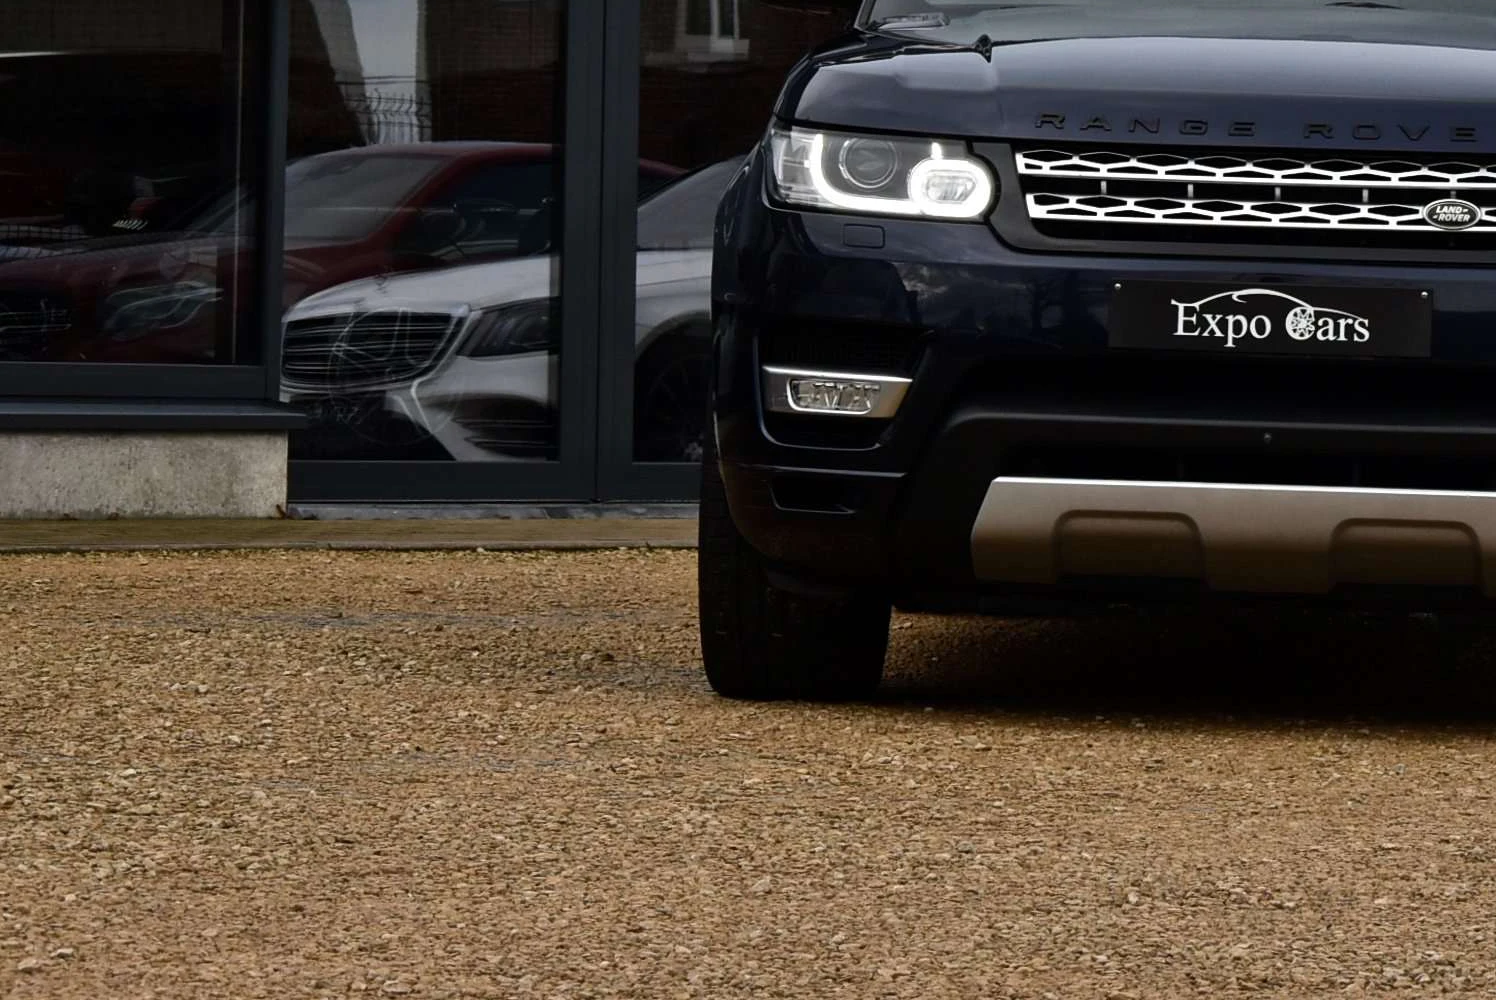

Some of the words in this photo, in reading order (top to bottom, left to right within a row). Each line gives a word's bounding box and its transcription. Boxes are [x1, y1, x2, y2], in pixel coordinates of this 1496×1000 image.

[1034, 112, 1257, 137] RANGE
[1172, 301, 1272, 348] Expo
[1285, 306, 1371, 342] Cars
